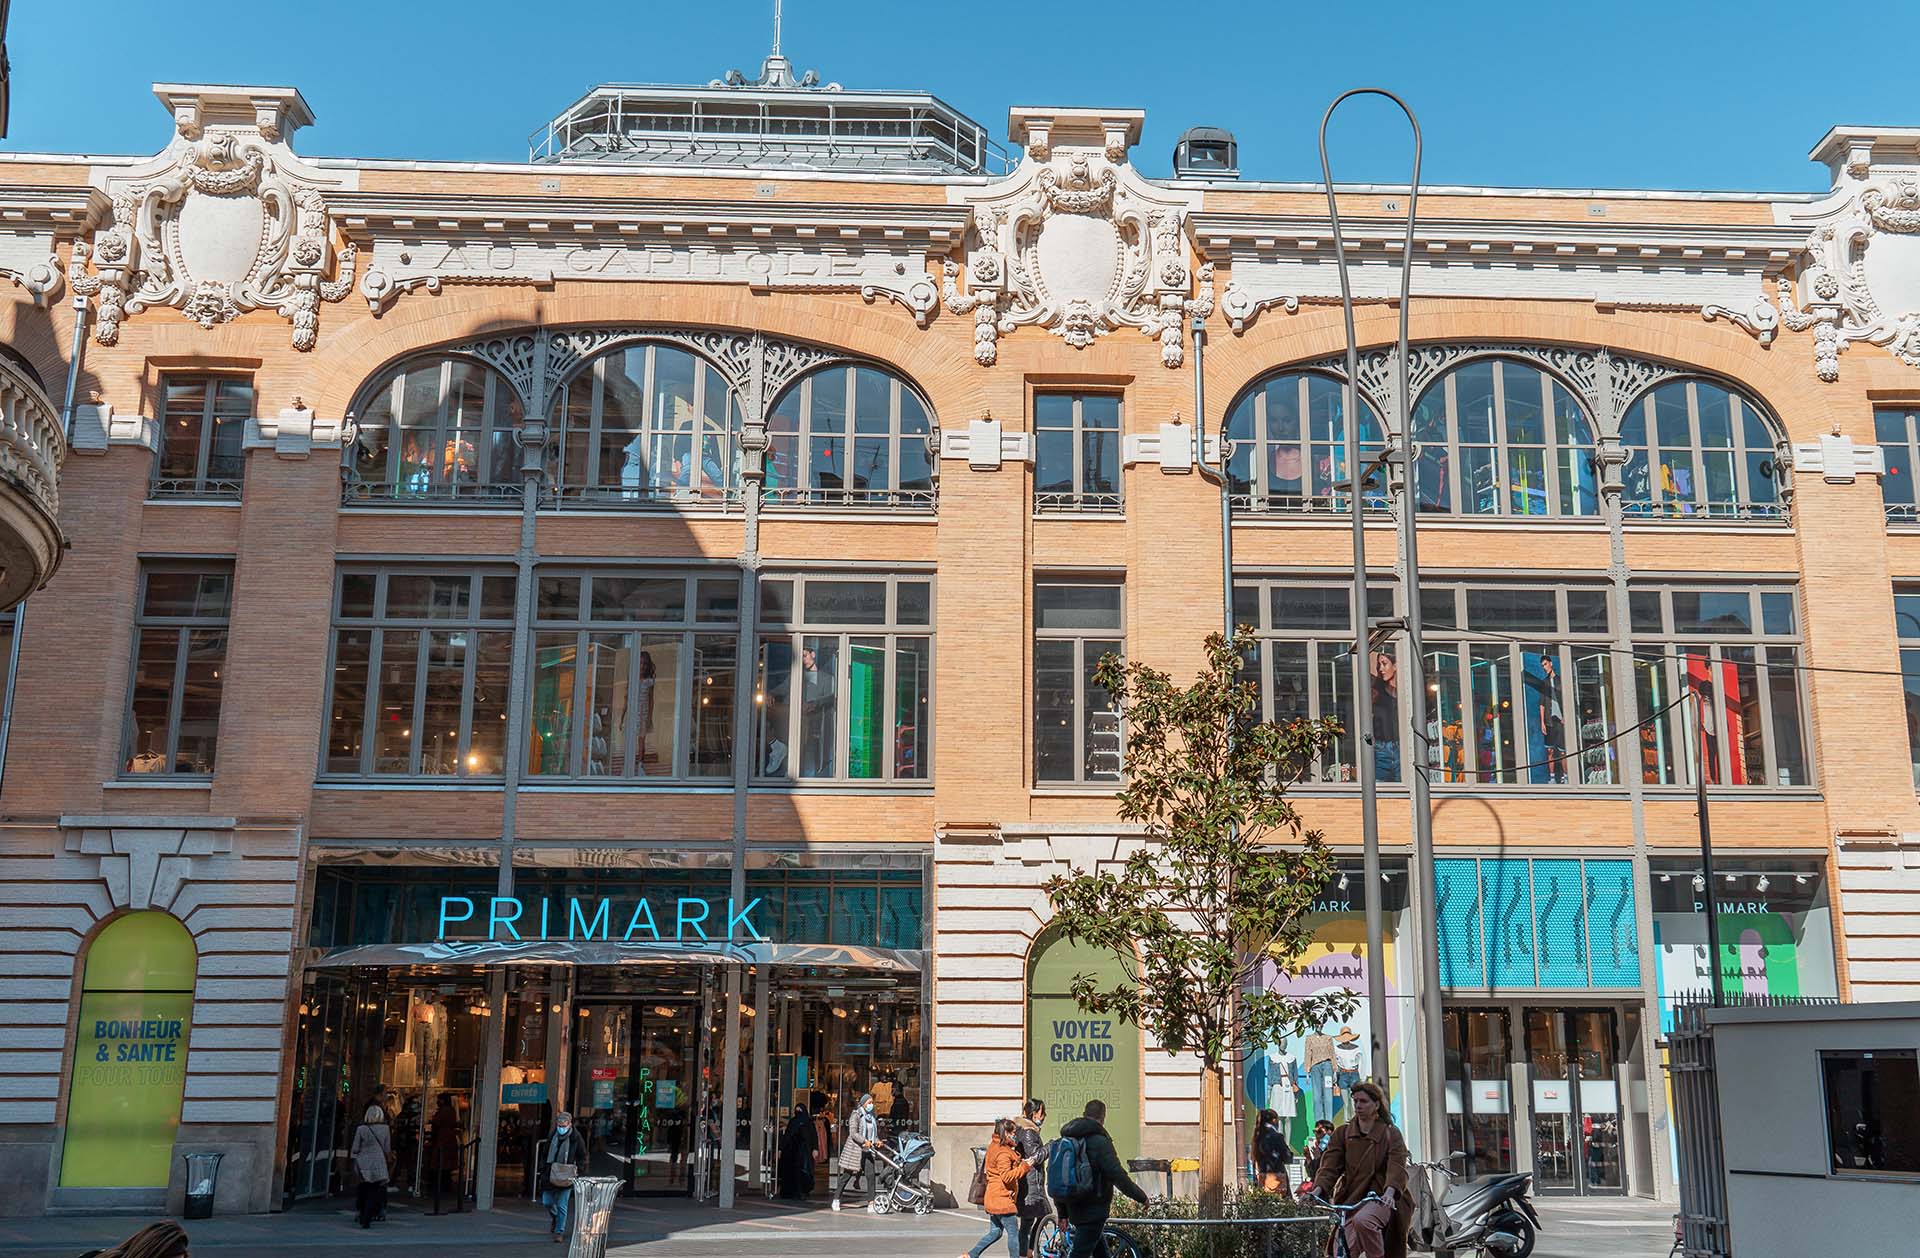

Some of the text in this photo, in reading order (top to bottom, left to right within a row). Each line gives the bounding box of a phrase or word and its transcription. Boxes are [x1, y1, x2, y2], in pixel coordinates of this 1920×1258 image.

[432, 246, 864, 277] AU CAPITOLE
[1694, 902, 1769, 914] PIMARK
[438, 897, 762, 941] PRIMARK
[95, 1020, 182, 1039] BONHEUR
[1052, 1021, 1112, 1039] VOYEZ
[95, 1038, 177, 1062] & SANTÉ
[1050, 1043, 1114, 1062] GRAND
